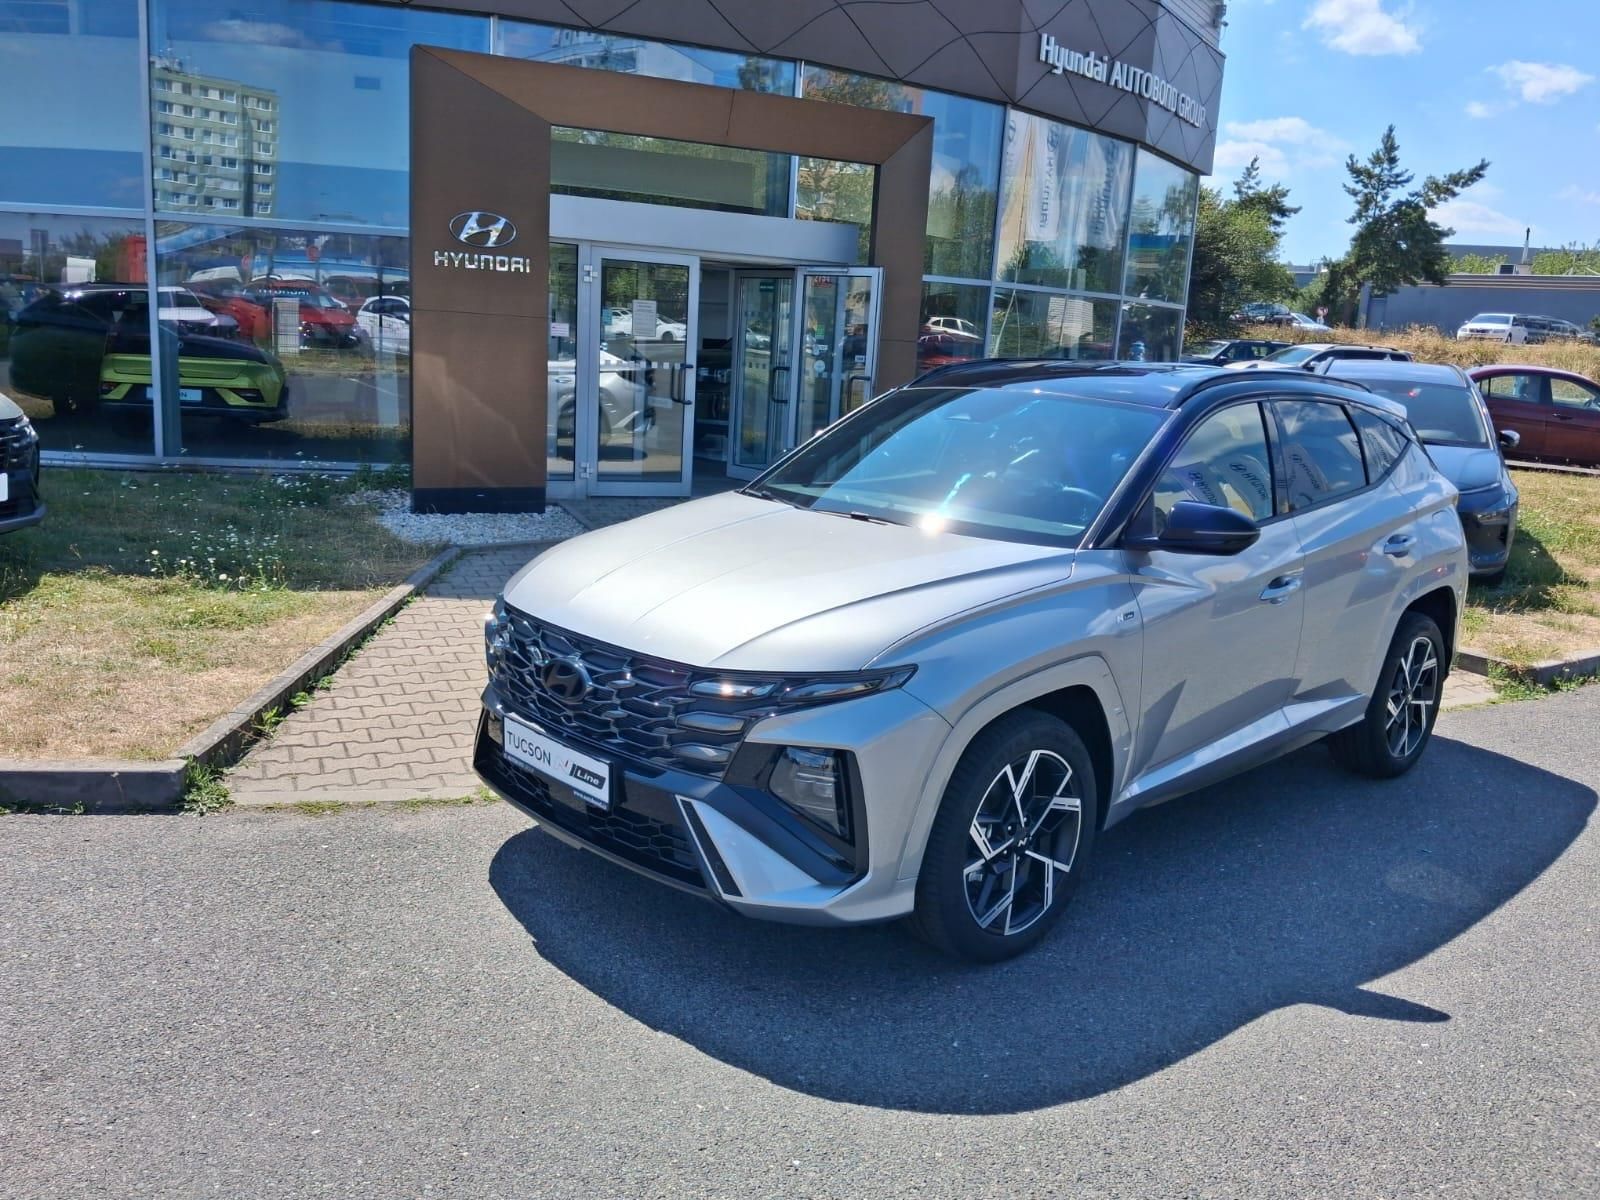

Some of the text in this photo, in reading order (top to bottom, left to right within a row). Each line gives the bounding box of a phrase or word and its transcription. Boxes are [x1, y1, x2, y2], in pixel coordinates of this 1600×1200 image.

[1039, 33, 1207, 128] Hyundai AUTOBOND GROUP
[434, 250, 530, 273] HYUNDAI
[507, 731, 551, 766] TUCSON
[577, 770, 600, 786] Line
